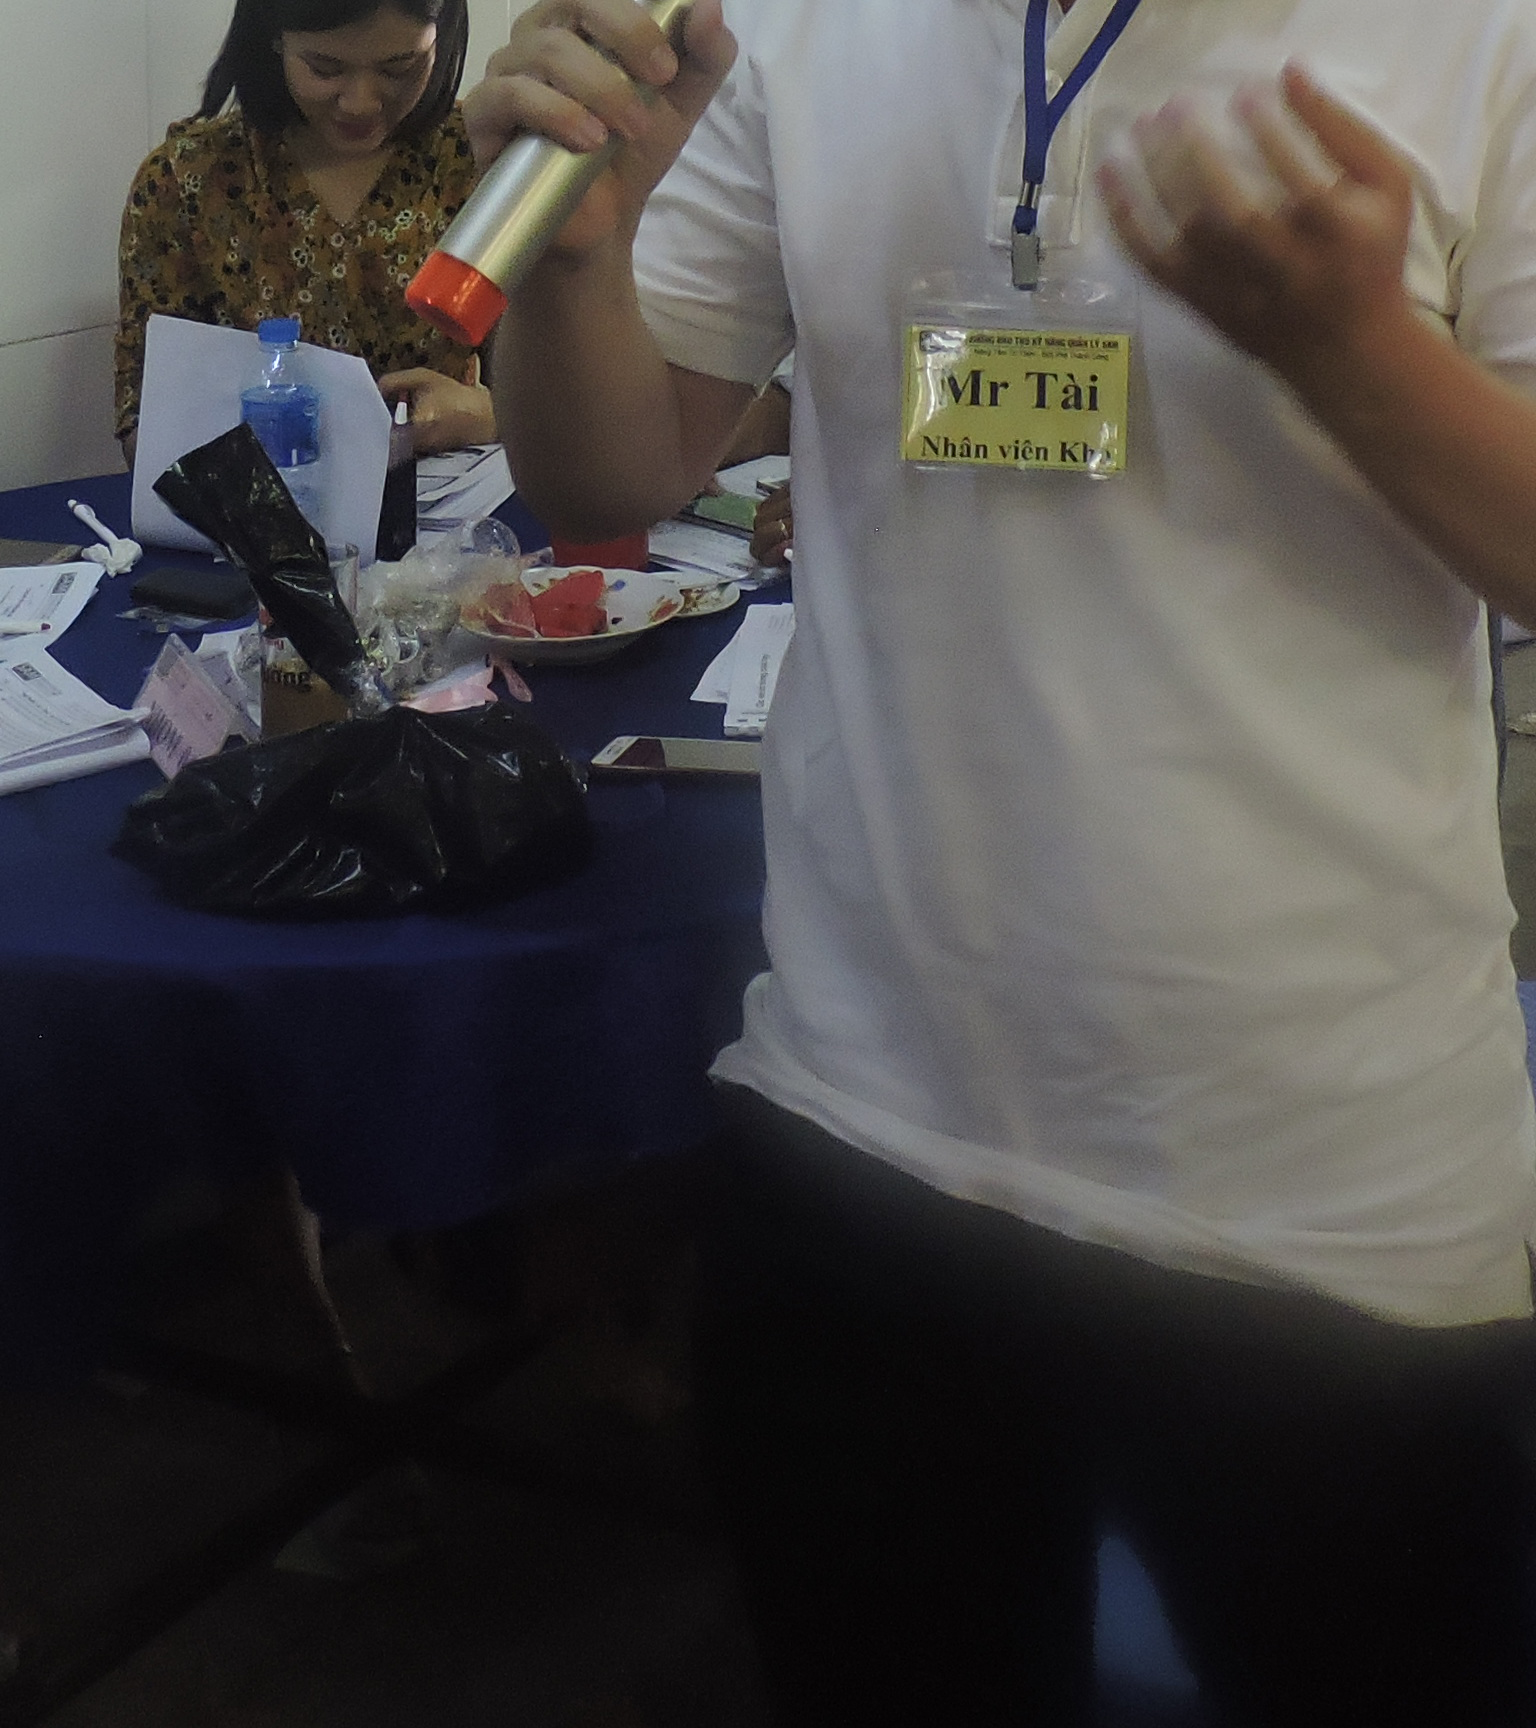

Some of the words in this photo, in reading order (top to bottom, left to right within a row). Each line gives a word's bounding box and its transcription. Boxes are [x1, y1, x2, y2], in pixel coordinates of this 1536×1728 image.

[939, 369, 1010, 407] Mr
[1025, 371, 1099, 412] Tài
[921, 435, 989, 460] Nhân
[998, 439, 1050, 462] viên
